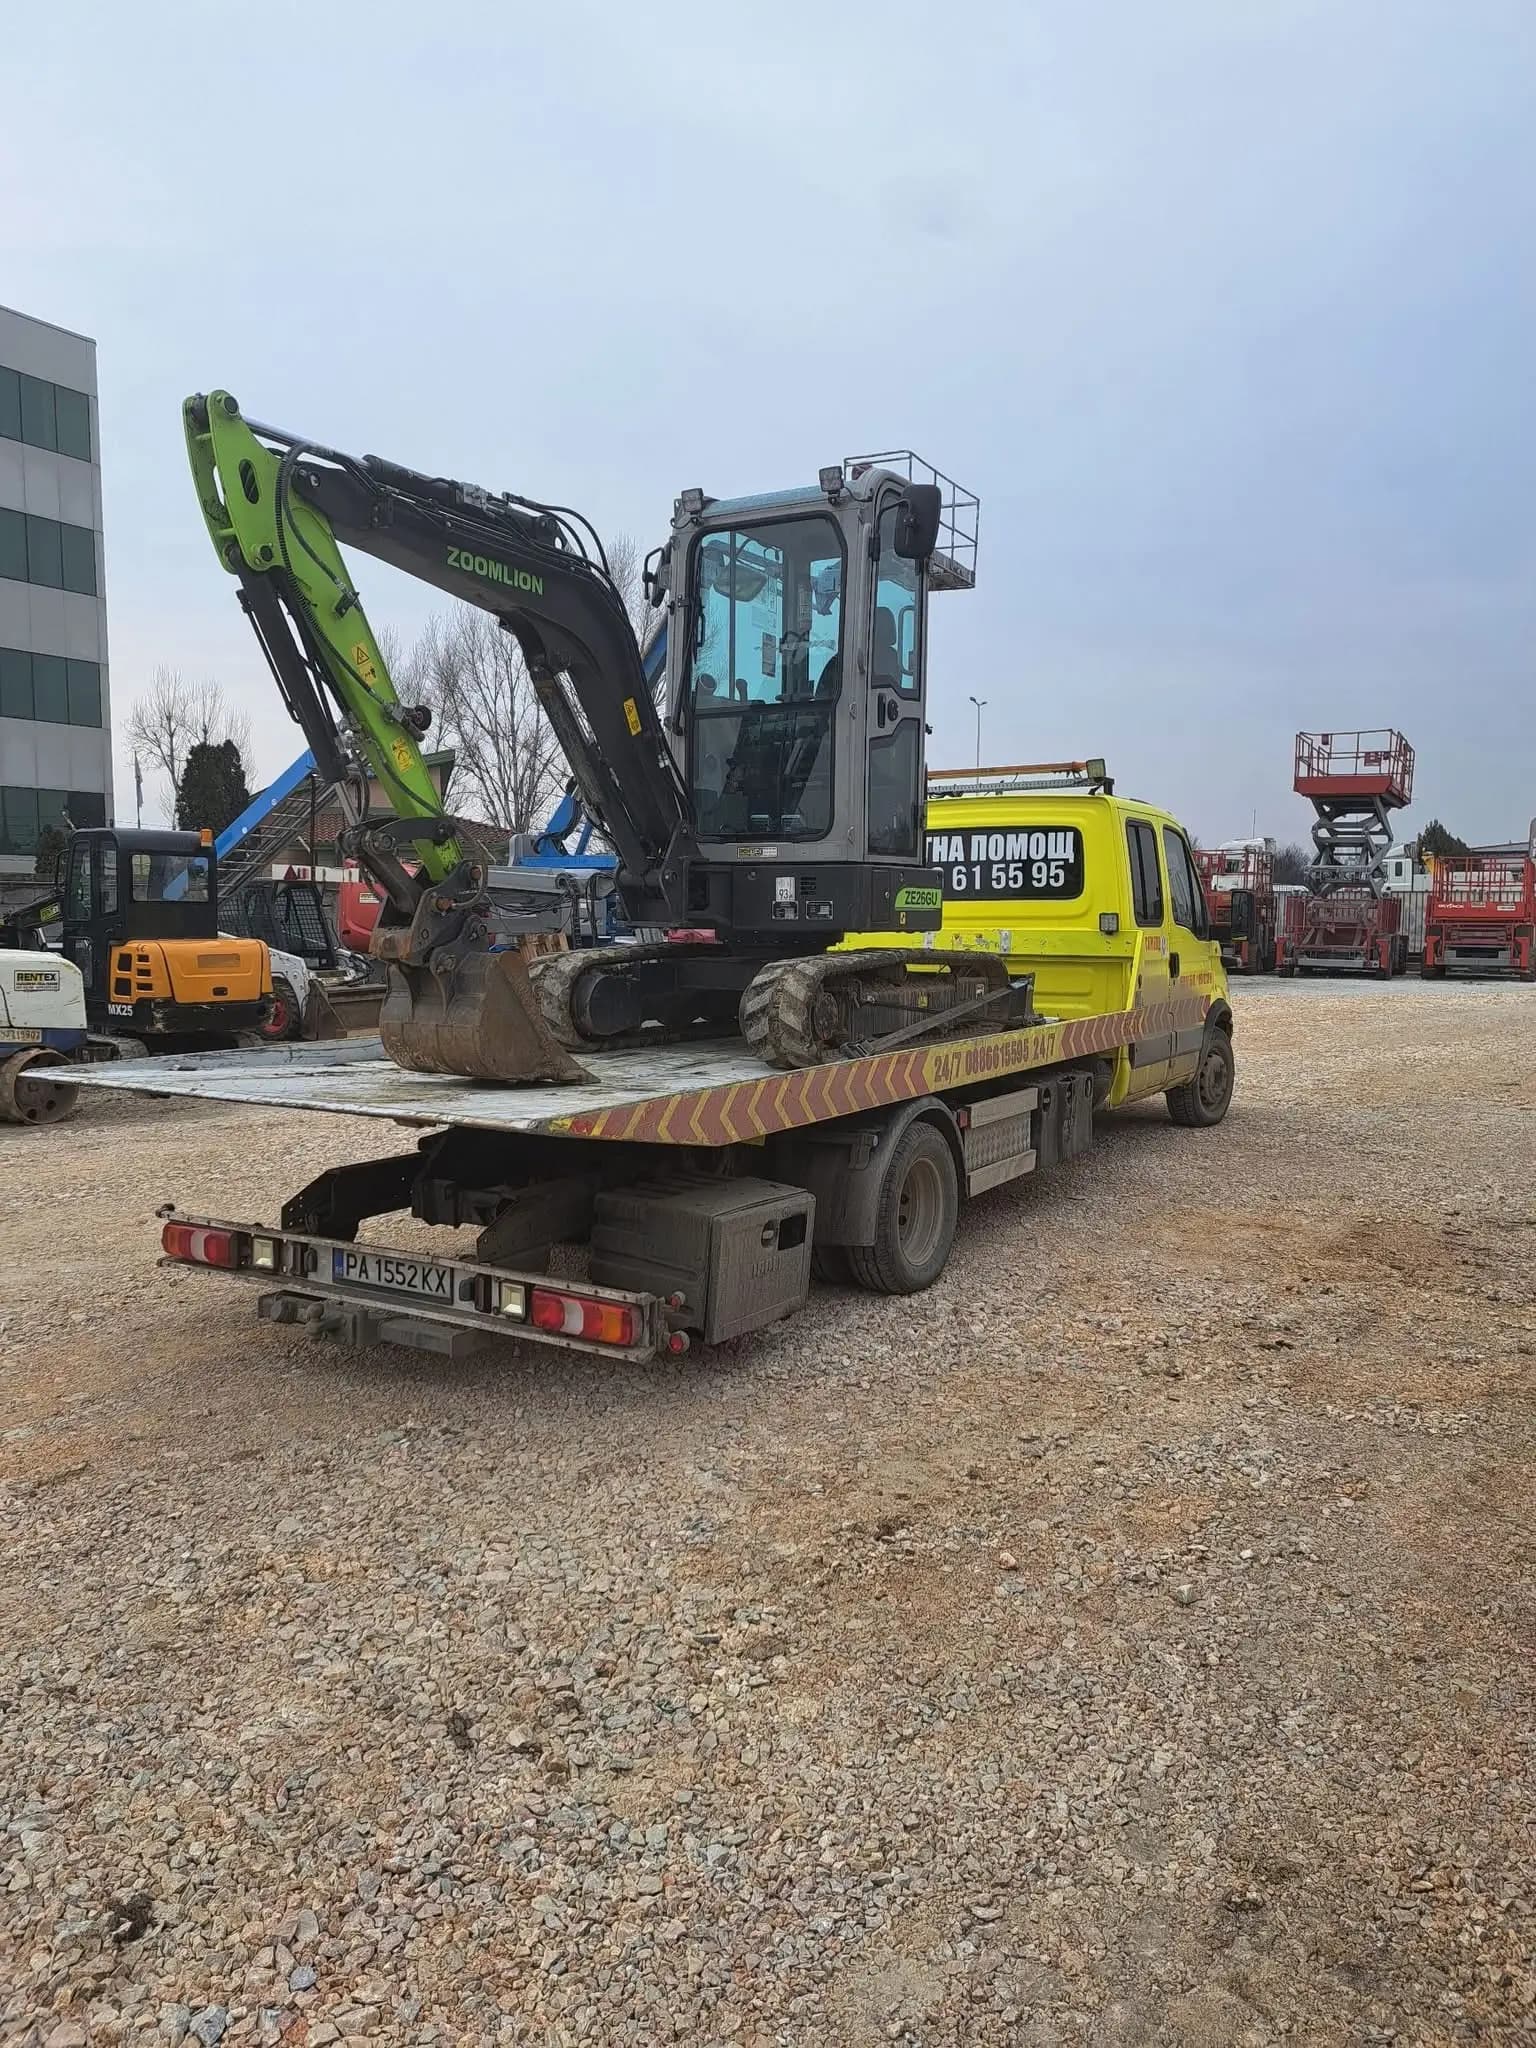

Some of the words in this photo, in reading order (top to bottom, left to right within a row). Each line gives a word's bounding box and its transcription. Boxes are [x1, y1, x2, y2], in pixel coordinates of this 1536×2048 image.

[447, 545, 543, 595] ZOOMLION
[971, 831, 1074, 863] ПОМОЩ
[952, 865, 981, 890] 61
[991, 862, 1023, 889] 55
[1031, 861, 1065, 887] 95
[904, 889, 937, 906] ZE26GU
[17, 973, 56, 981] RENTEX
[108, 1004, 133, 1016] MX25
[934, 1050, 961, 1084] 24/7
[1033, 1033, 1056, 1062] 24/7
[346, 1253, 369, 1279] PA
